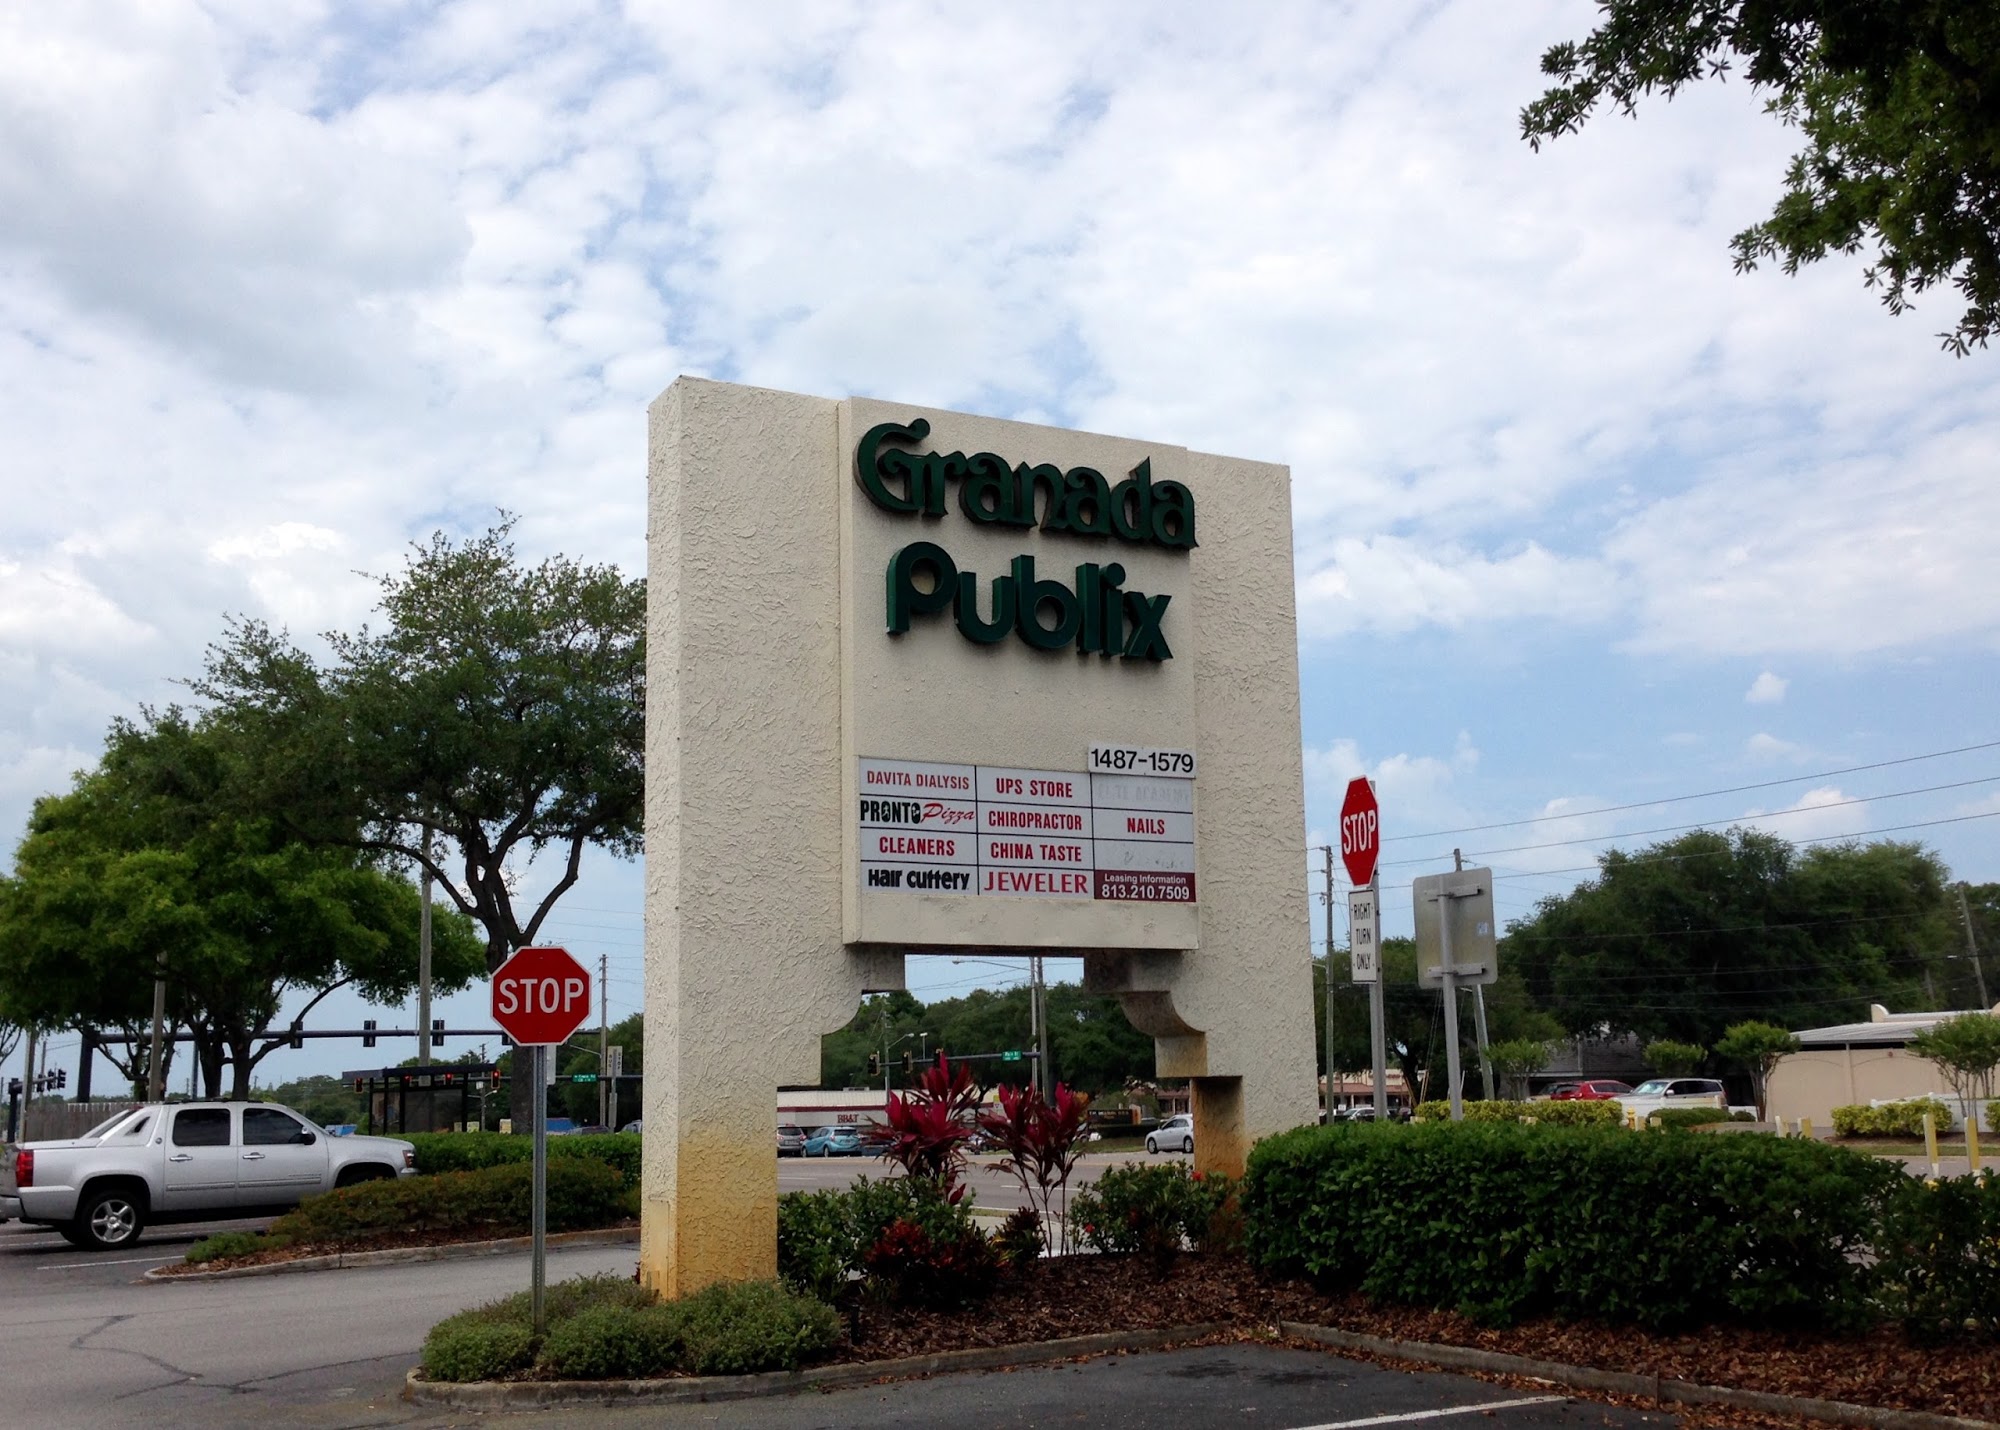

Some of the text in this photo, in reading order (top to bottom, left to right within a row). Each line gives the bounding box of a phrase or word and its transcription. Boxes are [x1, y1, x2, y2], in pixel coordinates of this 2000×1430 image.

[853, 418, 1199, 550] Granada
[886, 541, 1173, 660] Publix
[1091, 748, 1194, 773] 1487-1579
[867, 770, 970, 790] DAVITA DIALYSIS
[996, 778, 1073, 798] UPS STORE
[860, 800, 975, 825] PRONTO Pizza
[988, 811, 1082, 830] CHIROPRACTOR
[1127, 817, 1165, 835] NAILS
[1343, 809, 1377, 855] STOP
[879, 836, 955, 856] CLEANERS
[990, 842, 1082, 862] CHINA TASTE
[868, 869, 903, 888] Hair
[983, 871, 1088, 894] JEWELER
[1104, 873, 1187, 885] Leasing Information
[1101, 884, 1190, 900] 813.210.7509
[1353, 903, 1371, 920] RIGHT
[1355, 928, 1371, 944] TURN
[1356, 953, 1371, 970] ONLY
[498, 977, 584, 1014] STOP
[837, 1113, 859, 1123] BB&T
